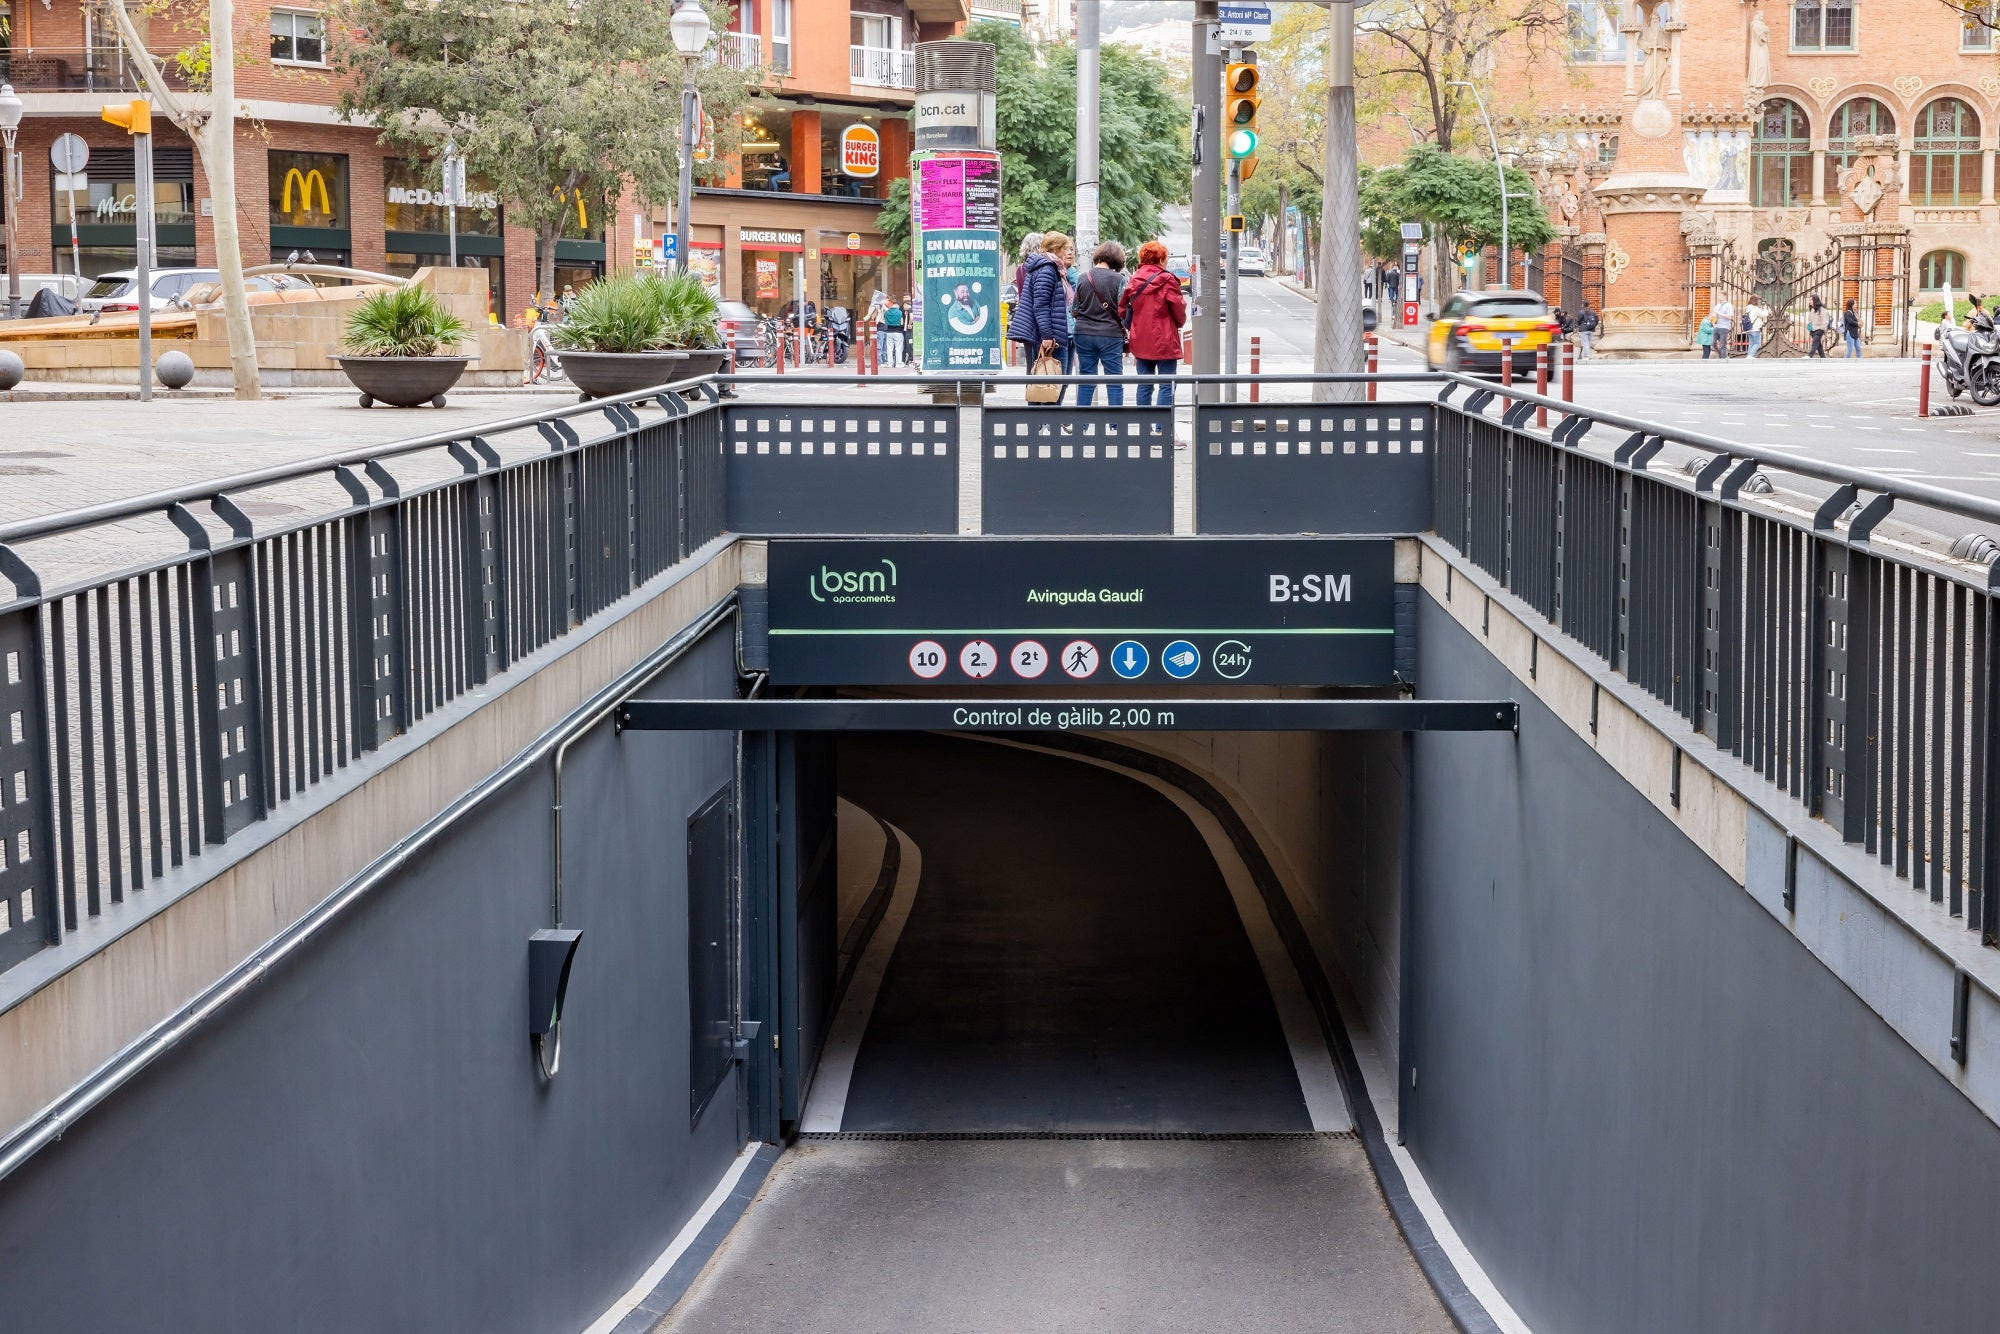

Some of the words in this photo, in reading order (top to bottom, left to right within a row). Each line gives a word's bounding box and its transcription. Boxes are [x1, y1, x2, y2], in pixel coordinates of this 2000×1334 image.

[1228, 10, 1243, 18] Antoni
[921, 104, 966, 116] bcn.cat
[845, 141, 877, 153] BURGER
[845, 151, 877, 166] KING
[667, 238, 673, 246] P
[740, 230, 777, 243] BURGER
[778, 232, 802, 244] KING
[926, 240, 942, 251] EN
[944, 239, 997, 251] NAVIDAD
[926, 253, 945, 265] NO
[946, 252, 980, 264] VALE
[926, 266, 996, 278] ELFADARSE.
[948, 347, 984, 357] impro
[948, 355, 983, 365] show!
[821, 565, 886, 593] bsm
[1269, 574, 1352, 603] B:SM
[832, 594, 896, 604] aparcaments
[1026, 588, 1097, 606] Avinguda
[1098, 588, 1144, 603] Gaudí
[917, 651, 939, 667] 10
[1219, 653, 1246, 666] 24h
[953, 707, 1022, 726] Control
[1027, 707, 1052, 726] de
[1057, 706, 1104, 730] gàlib
[1109, 708, 1151, 728] 2,00
[1157, 711, 1175, 725] m
